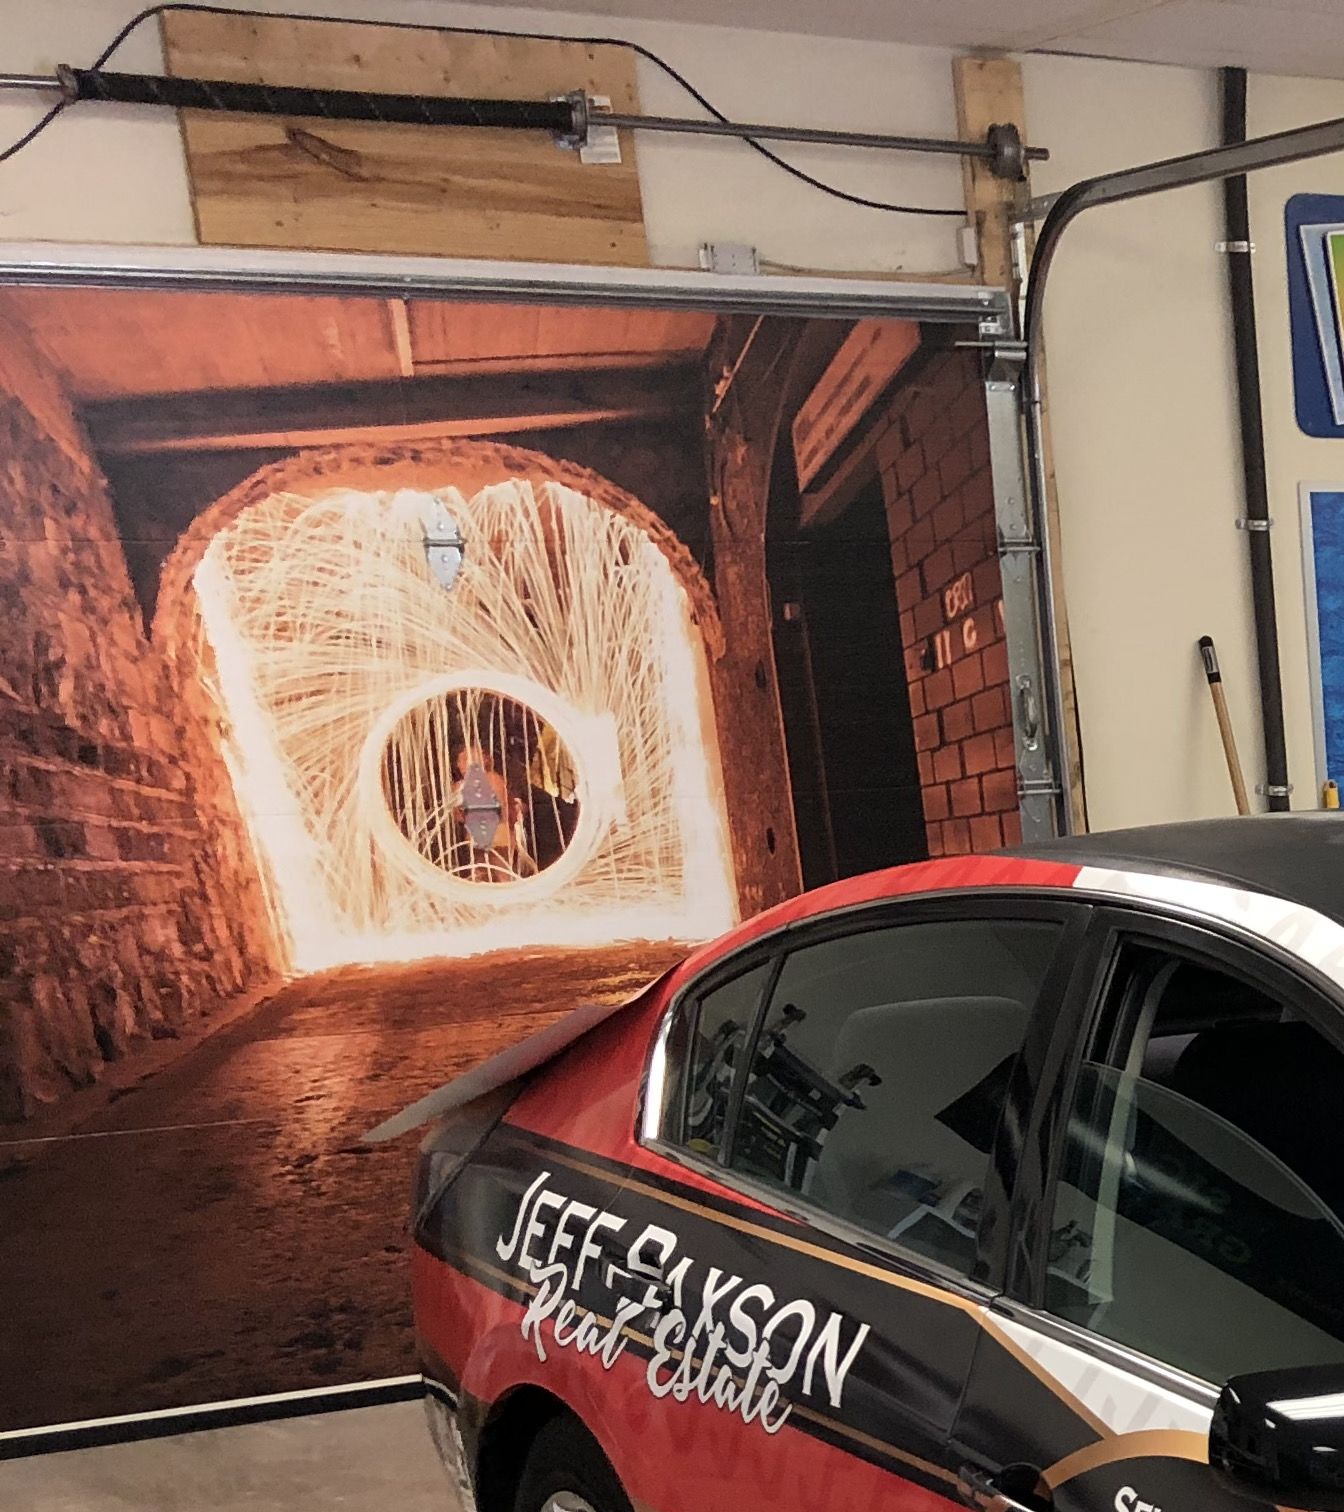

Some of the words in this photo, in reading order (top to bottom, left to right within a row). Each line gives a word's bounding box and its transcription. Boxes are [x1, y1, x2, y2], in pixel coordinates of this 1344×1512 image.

[496, 1171, 628, 1290] JEFF
[521, 1262, 643, 1370] Real
[646, 1306, 793, 1434] Estate
